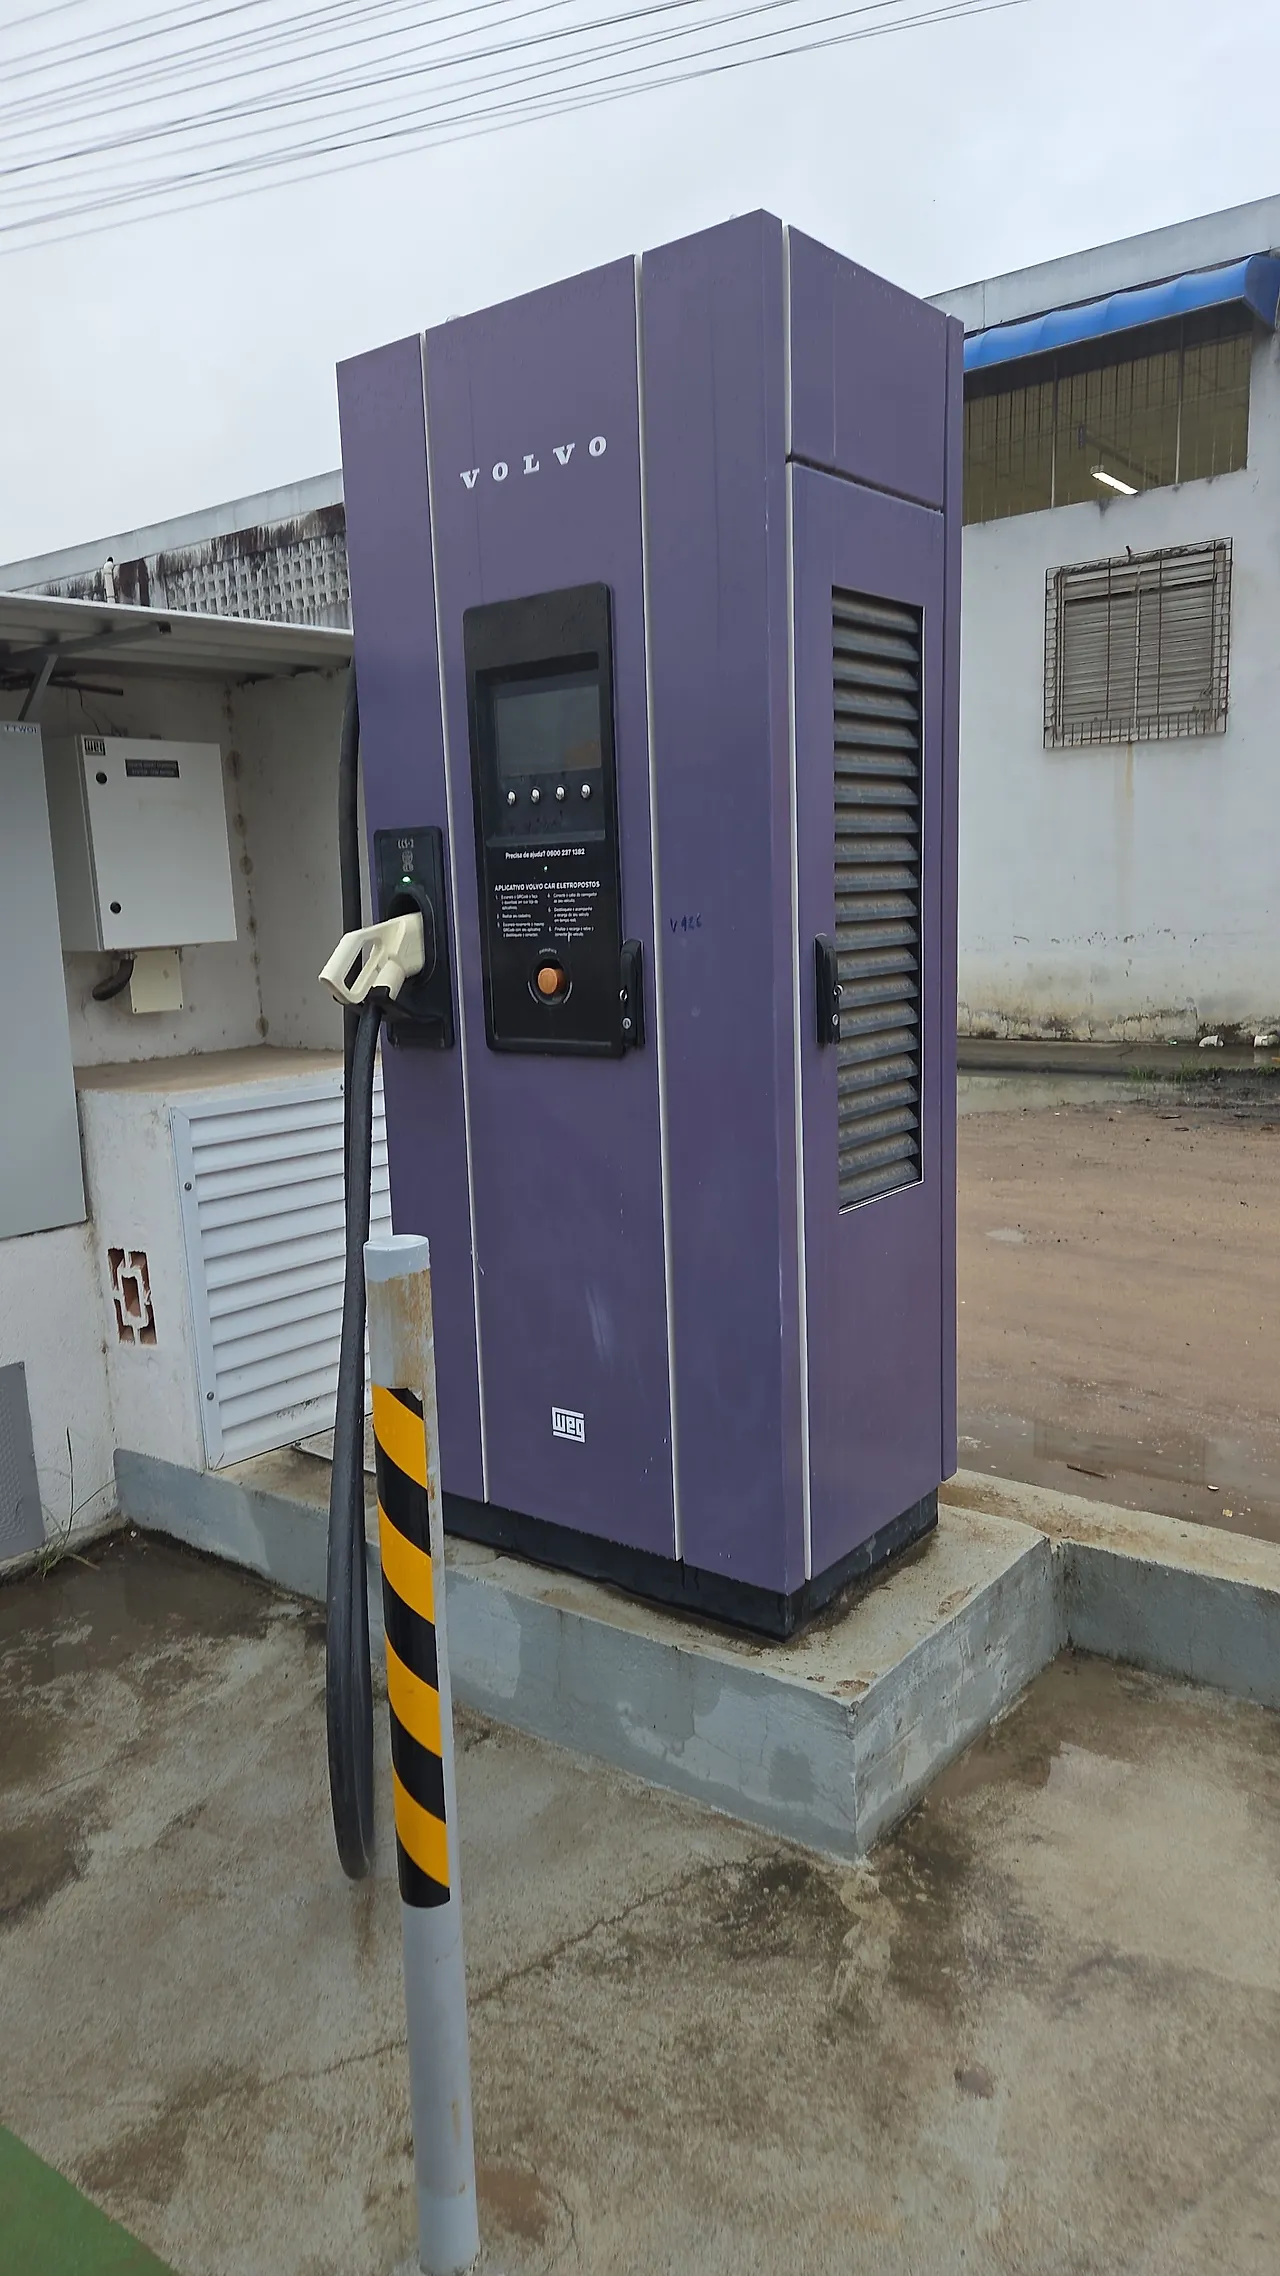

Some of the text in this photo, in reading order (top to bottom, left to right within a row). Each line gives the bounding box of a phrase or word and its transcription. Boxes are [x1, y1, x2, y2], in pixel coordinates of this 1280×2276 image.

[459, 435, 607, 489] VOLVO
[505, 851, 522, 860] Precisa
[547, 849, 560, 857] 0800
[494, 880, 600, 892] APLICATIVO VOLVO CAR ELETROPOSTOS
